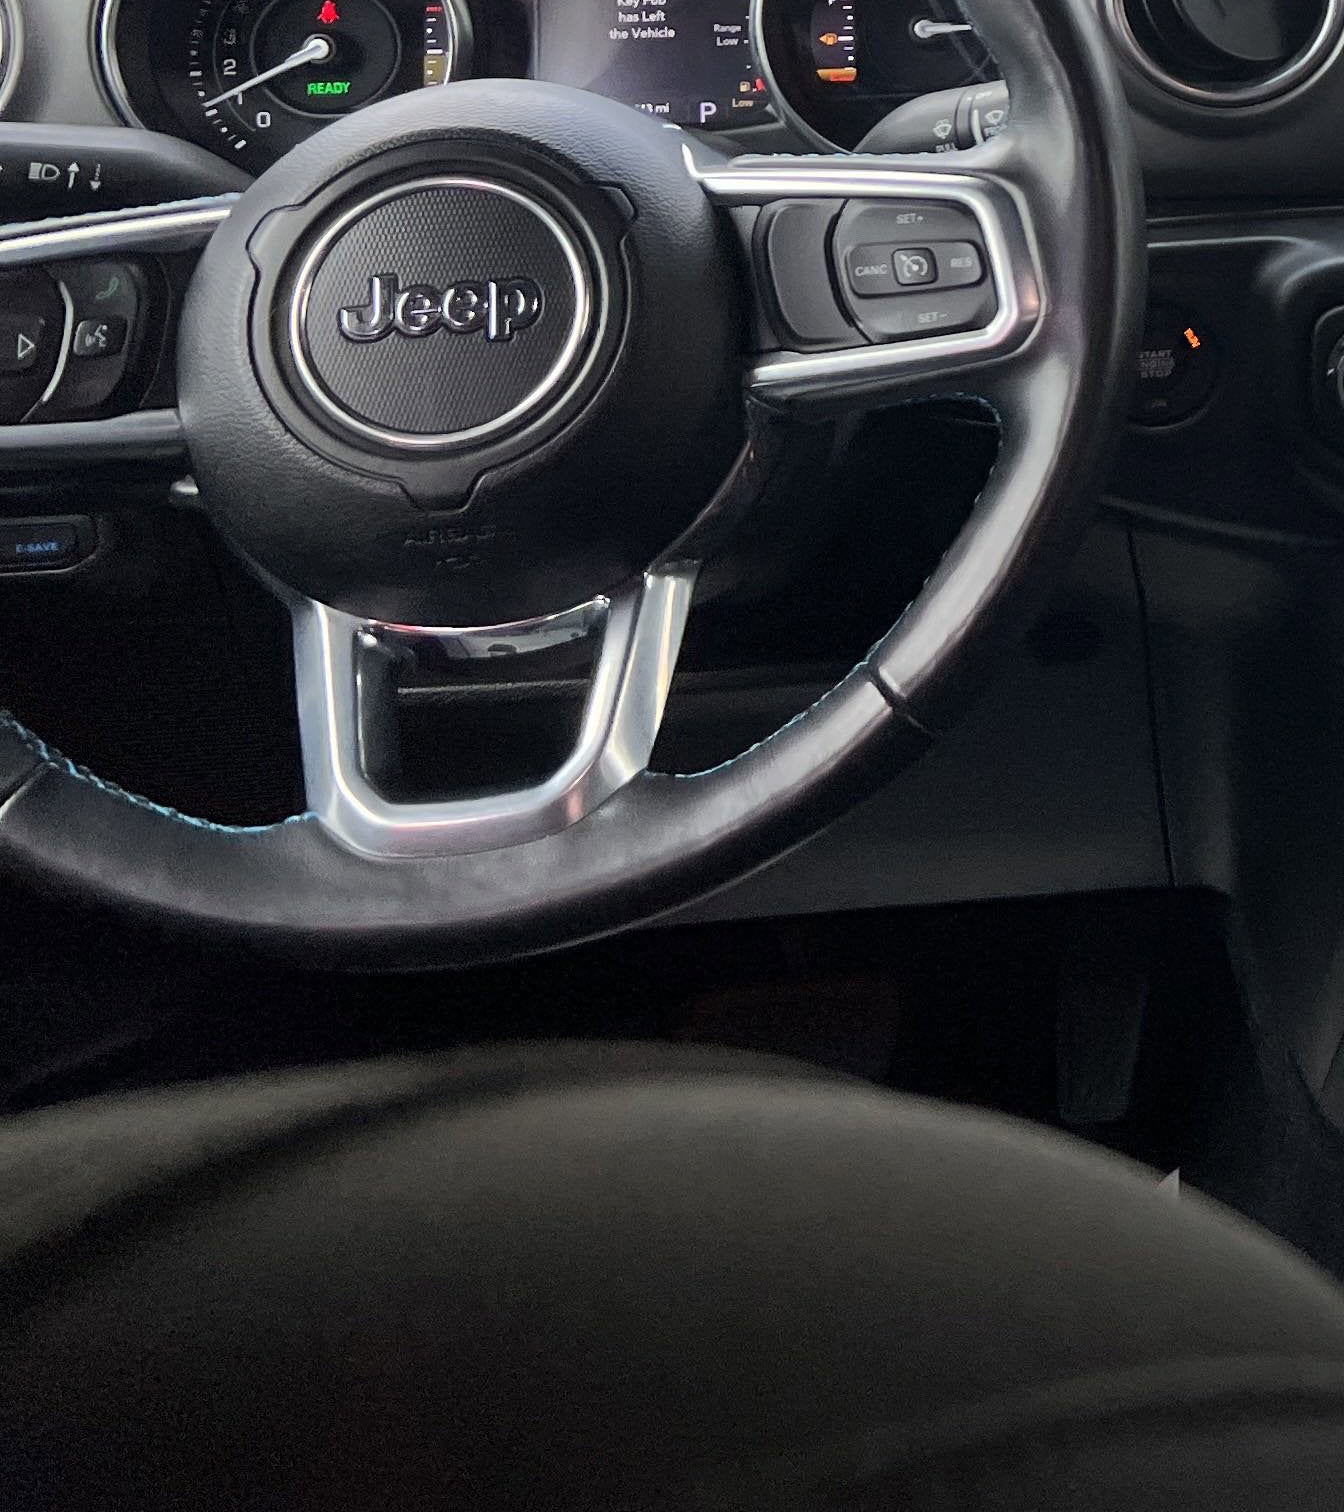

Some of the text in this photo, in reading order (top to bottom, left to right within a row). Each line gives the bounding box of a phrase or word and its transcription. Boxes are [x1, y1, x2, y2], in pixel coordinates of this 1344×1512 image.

[618, 10, 666, 23] has Left
[609, 26, 676, 40] the Vehicle
[713, 23, 742, 34] Range
[716, 36, 739, 47] Low
[223, 58, 237, 76] 2
[307, 81, 351, 96] READY
[655, 102, 670, 114] mi
[731, 98, 754, 108] Low
[256, 111, 272, 128] 0
[700, 101, 718, 124] P
[855, 263, 888, 277] CANC
[338, 273, 544, 342] Jeep
